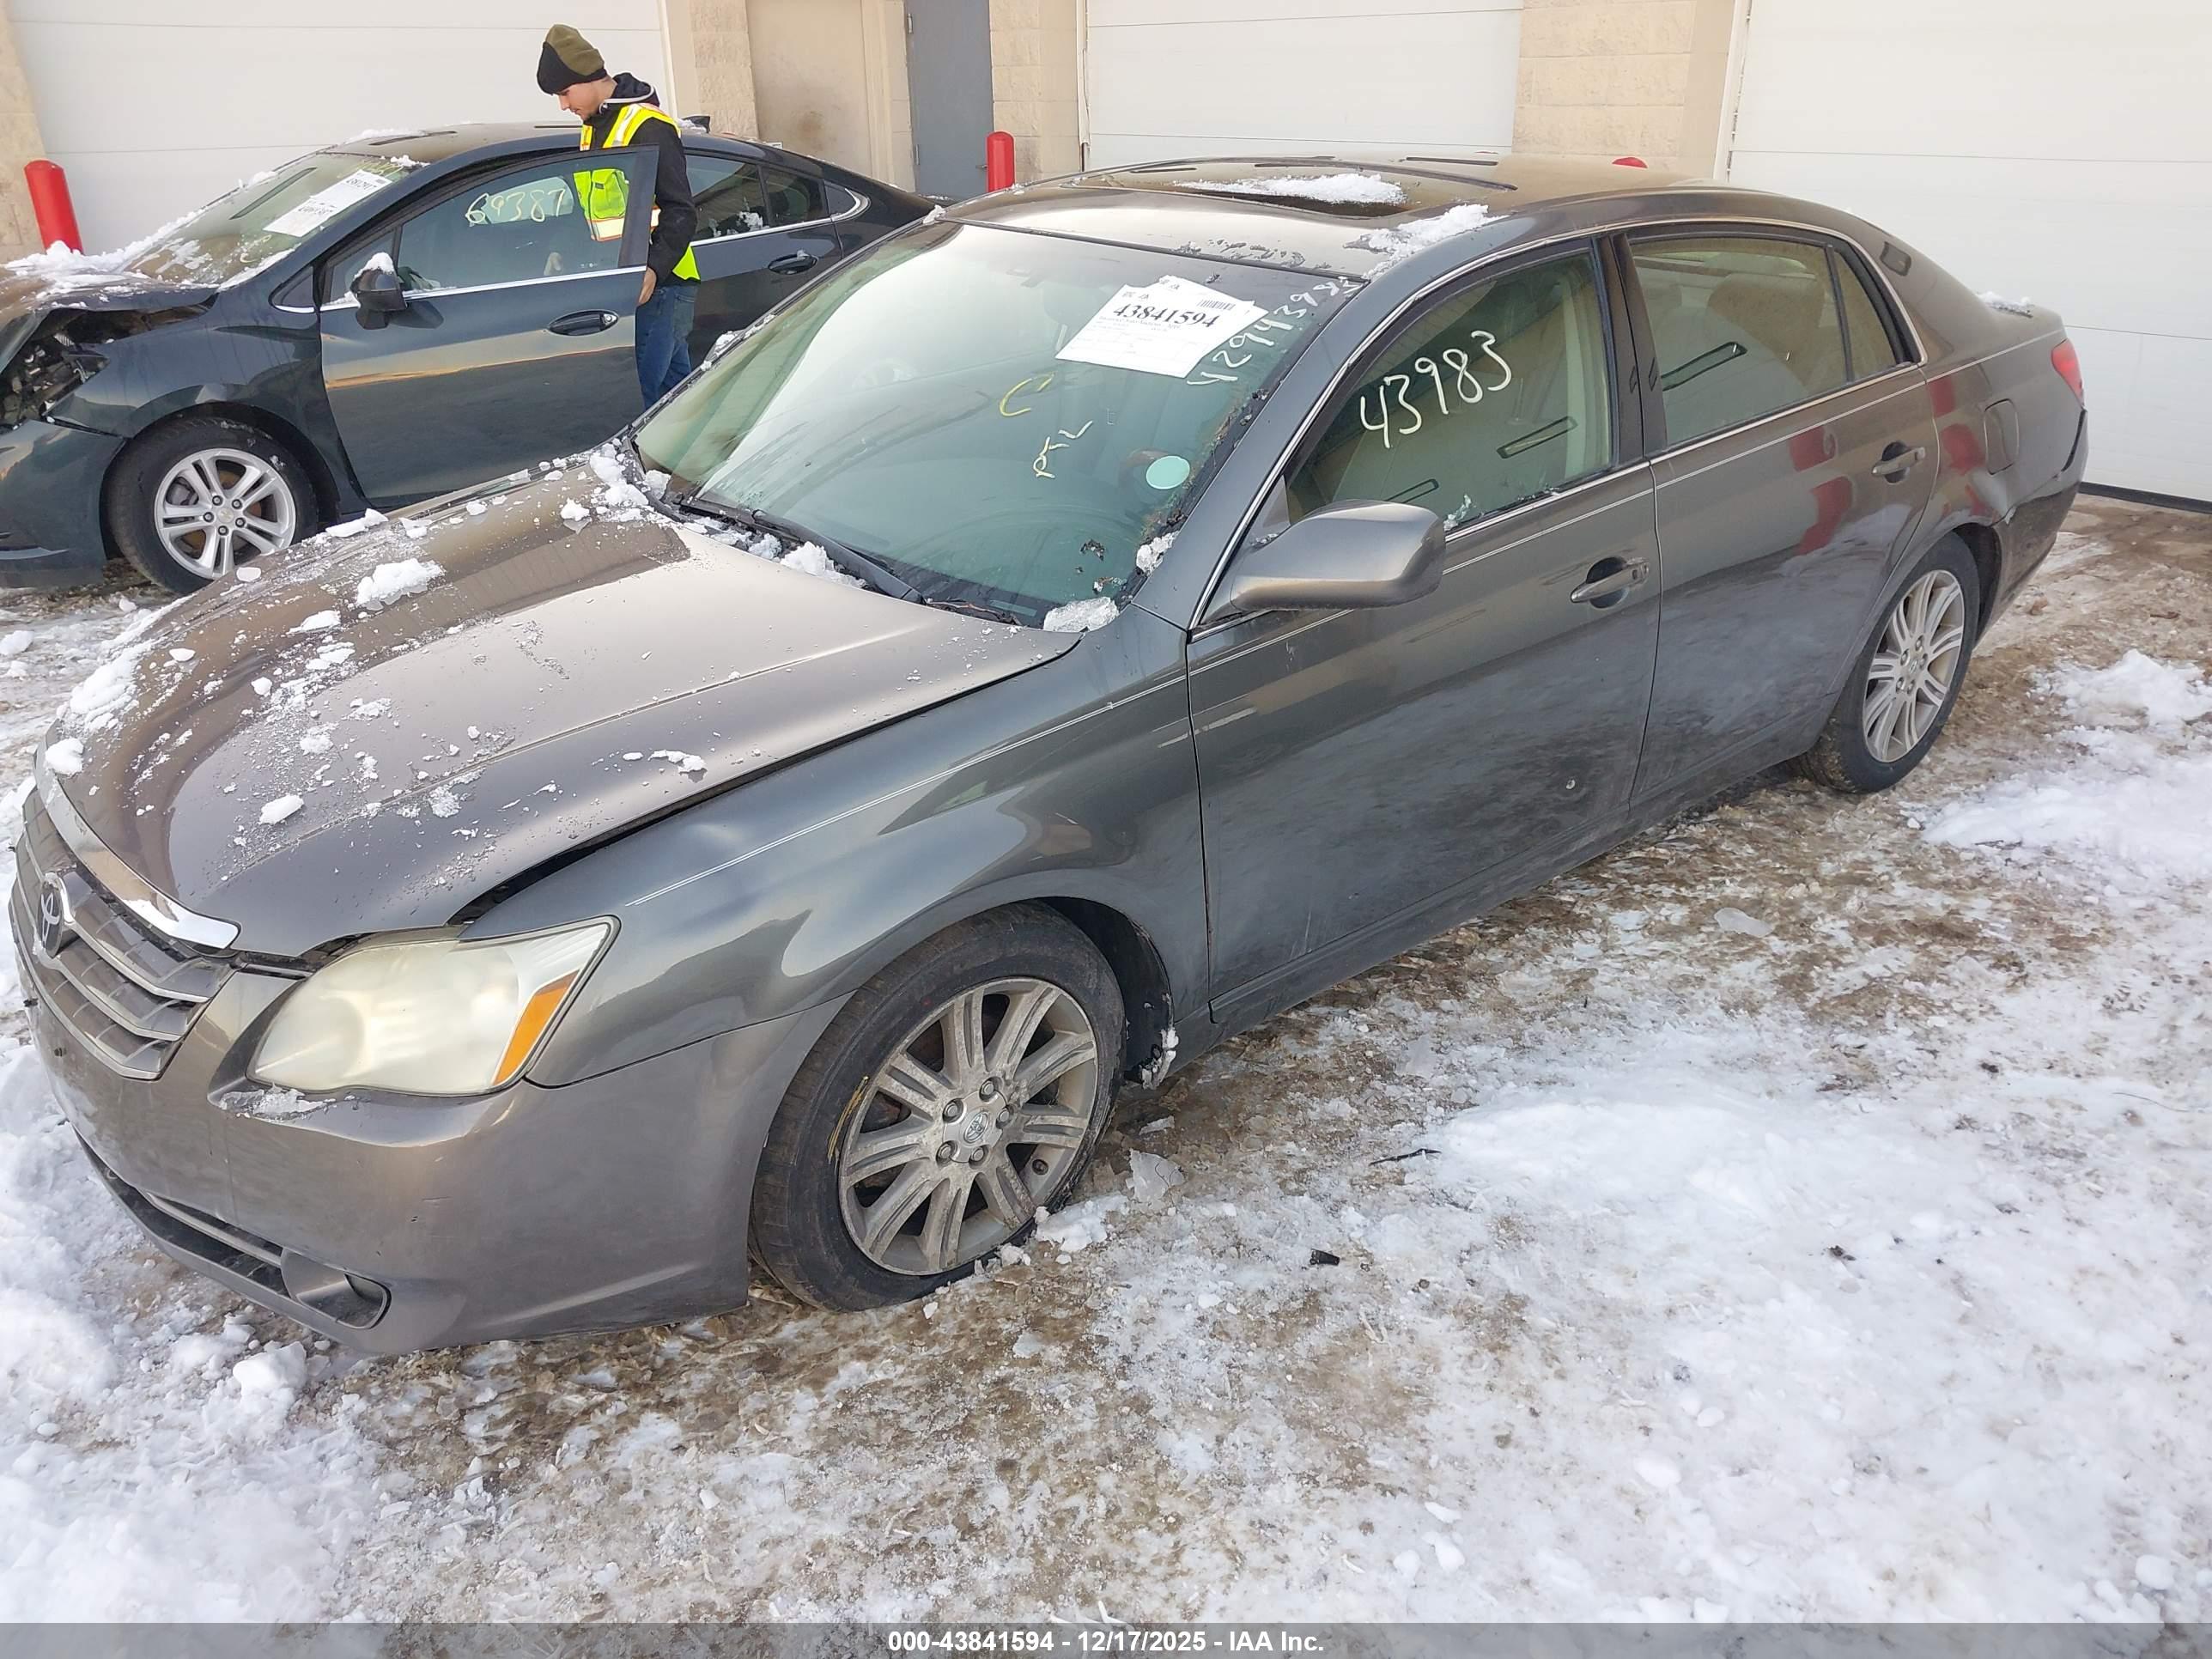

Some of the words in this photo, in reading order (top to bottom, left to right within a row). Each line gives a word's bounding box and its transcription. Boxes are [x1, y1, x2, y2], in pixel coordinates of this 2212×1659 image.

[465, 188, 566, 224] 69387
[1113, 303, 1220, 328] 43841594
[1360, 330, 1512, 449] 43983
